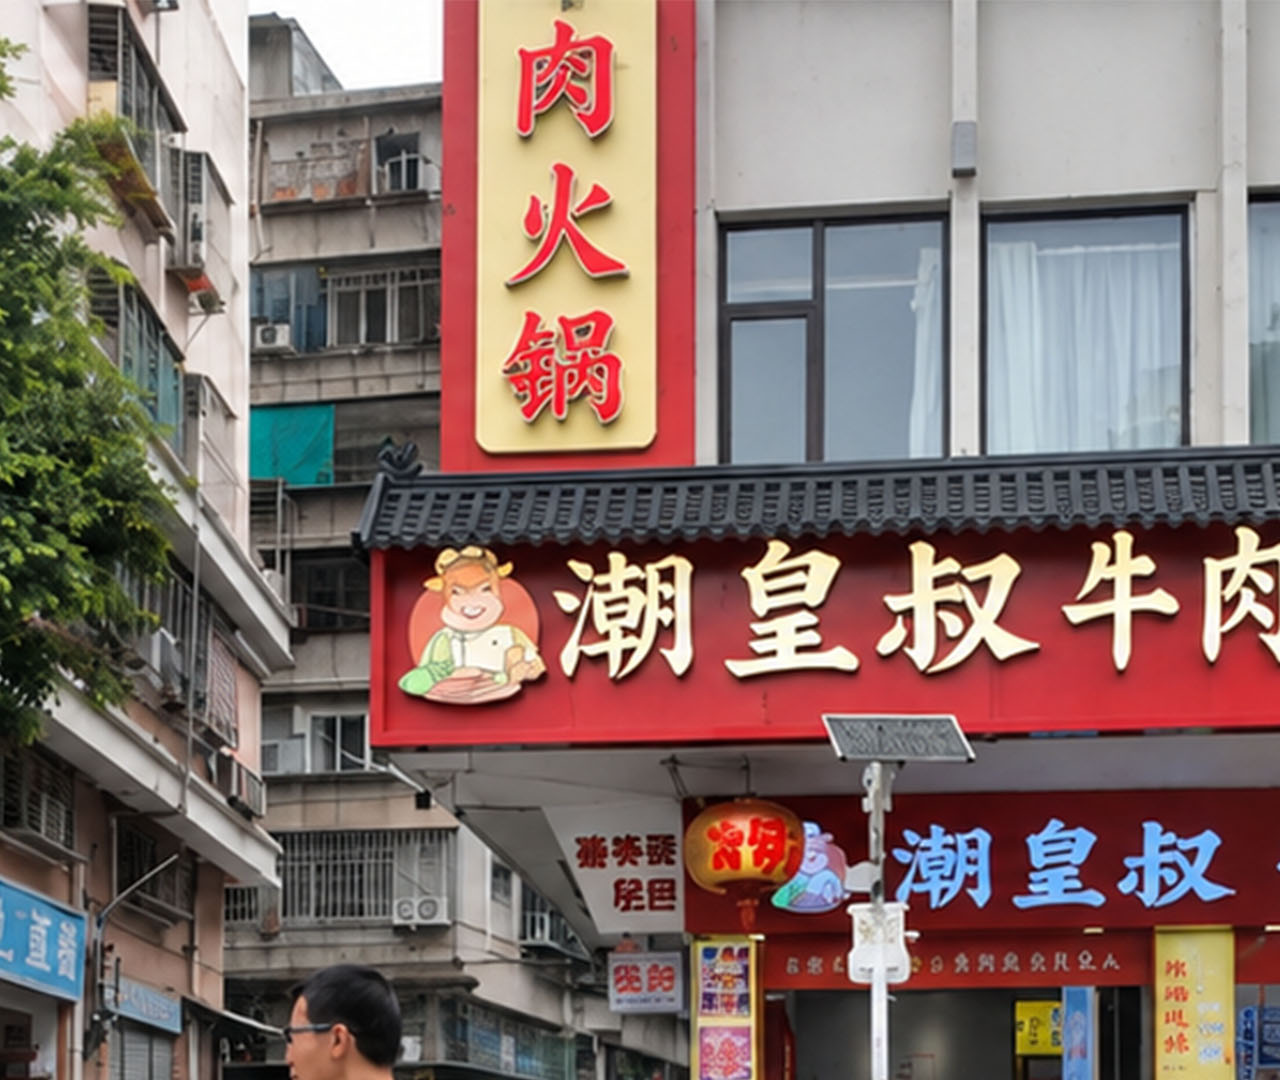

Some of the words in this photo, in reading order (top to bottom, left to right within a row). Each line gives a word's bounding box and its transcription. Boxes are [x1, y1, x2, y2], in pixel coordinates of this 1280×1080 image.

[504, 19, 629, 425] 肉火锅
[892, 818, 1236, 909] 潮皇叔
